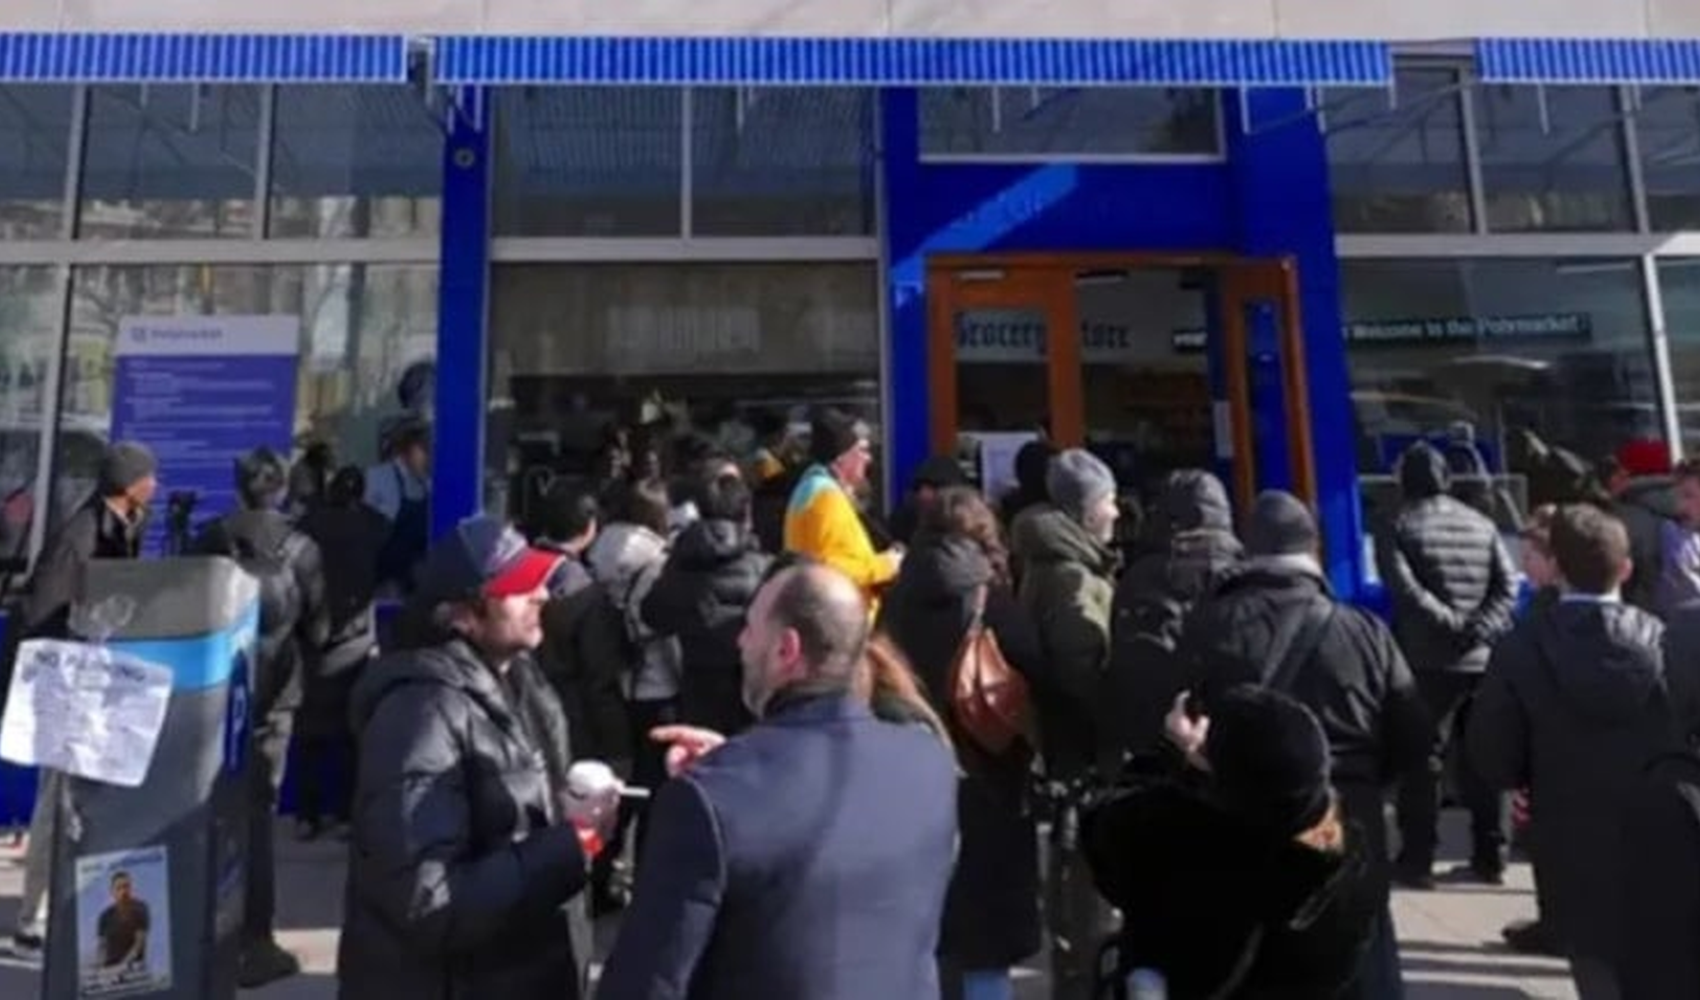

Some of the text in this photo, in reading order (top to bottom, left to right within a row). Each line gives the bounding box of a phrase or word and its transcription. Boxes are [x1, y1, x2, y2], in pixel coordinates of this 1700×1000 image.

[1080, 320, 1130, 348] tore
[1353, 323, 1418, 339] Welcome
[1421, 321, 1443, 336] to
[1446, 319, 1474, 335] the
